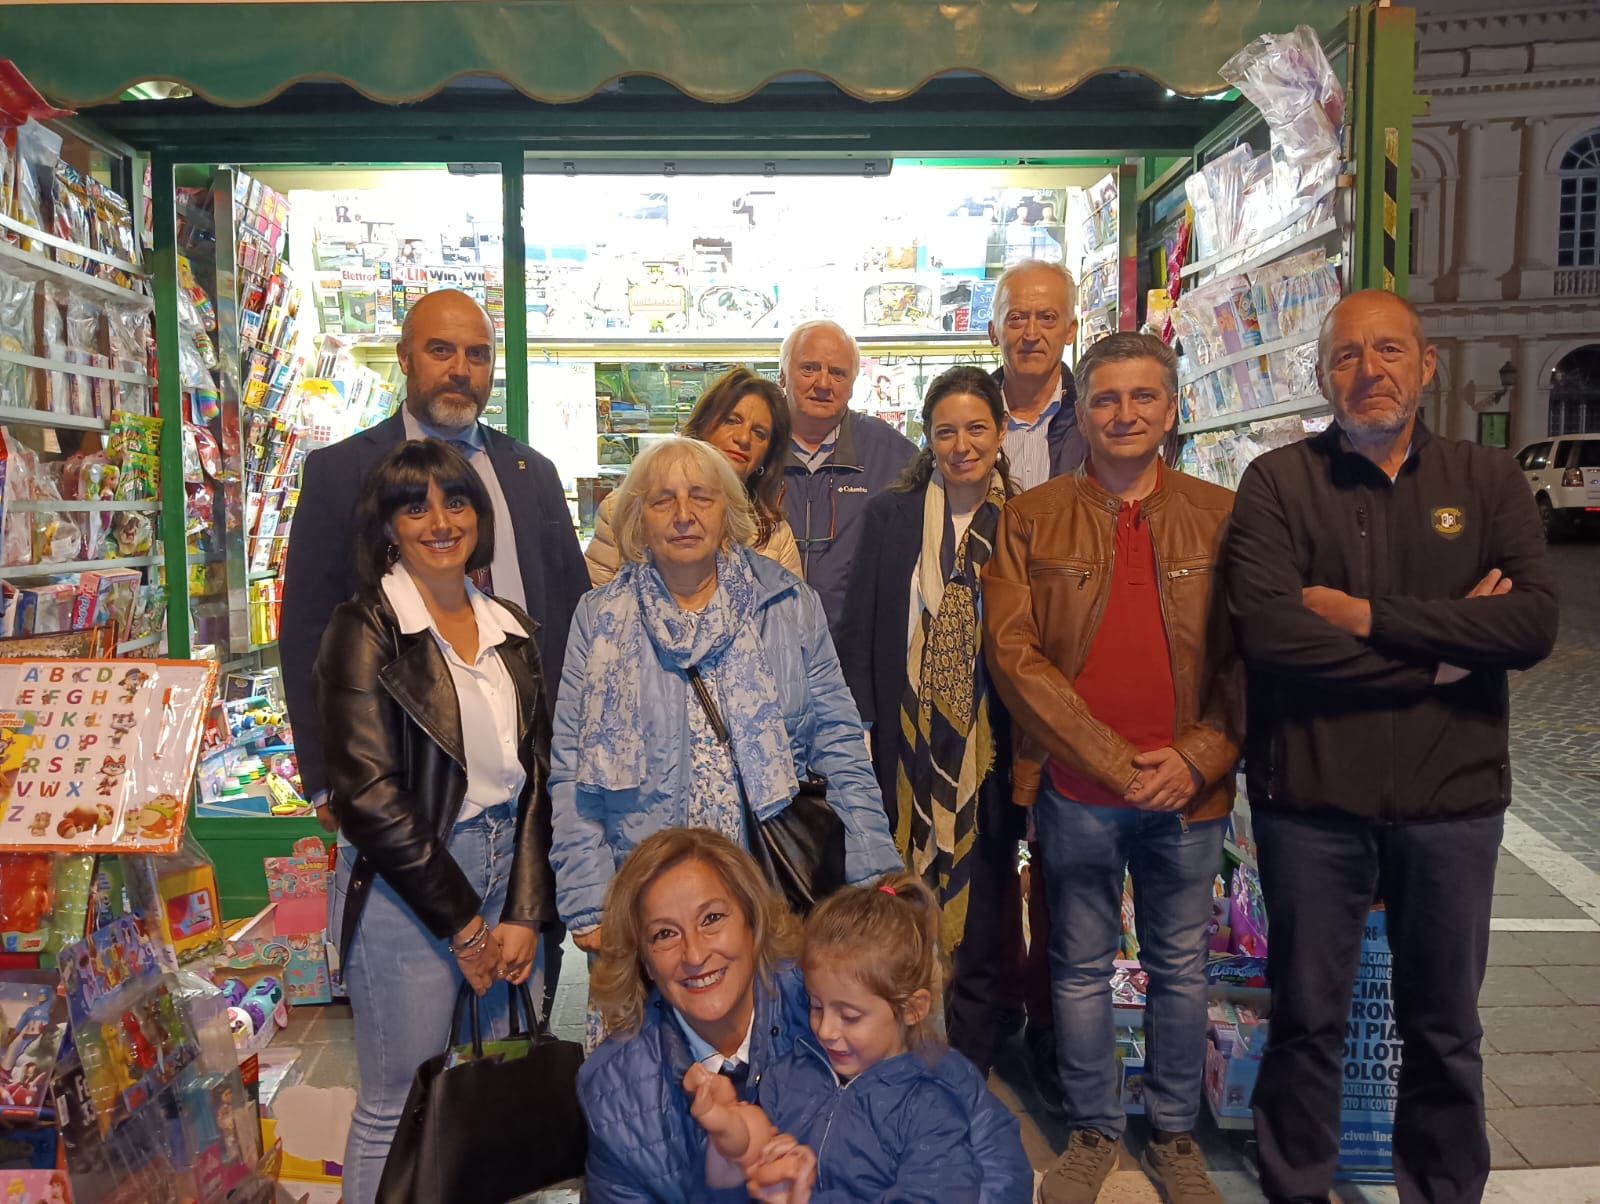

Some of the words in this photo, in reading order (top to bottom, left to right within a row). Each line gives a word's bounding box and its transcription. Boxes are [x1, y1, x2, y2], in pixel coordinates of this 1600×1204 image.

[24, 668, 39, 683] A
[49, 667, 64, 683] B
[96, 667, 113, 683] D
[22, 689, 35, 704] E
[66, 689, 83, 704] G
[91, 690, 108, 704] H
[60, 711, 77, 727] K
[54, 734, 70, 749] O
[84, 734, 98, 749] P
[25, 757, 41, 773] R
[48, 757, 63, 773] S
[17, 781, 34, 797] V
[39, 781, 61, 797] W
[66, 781, 83, 797] X
[7, 805, 25, 822] Z
[1366, 1023, 1399, 1041] PIA
[1364, 1043, 1403, 1062] LOT
[1344, 1062, 1401, 1081] OLOG
